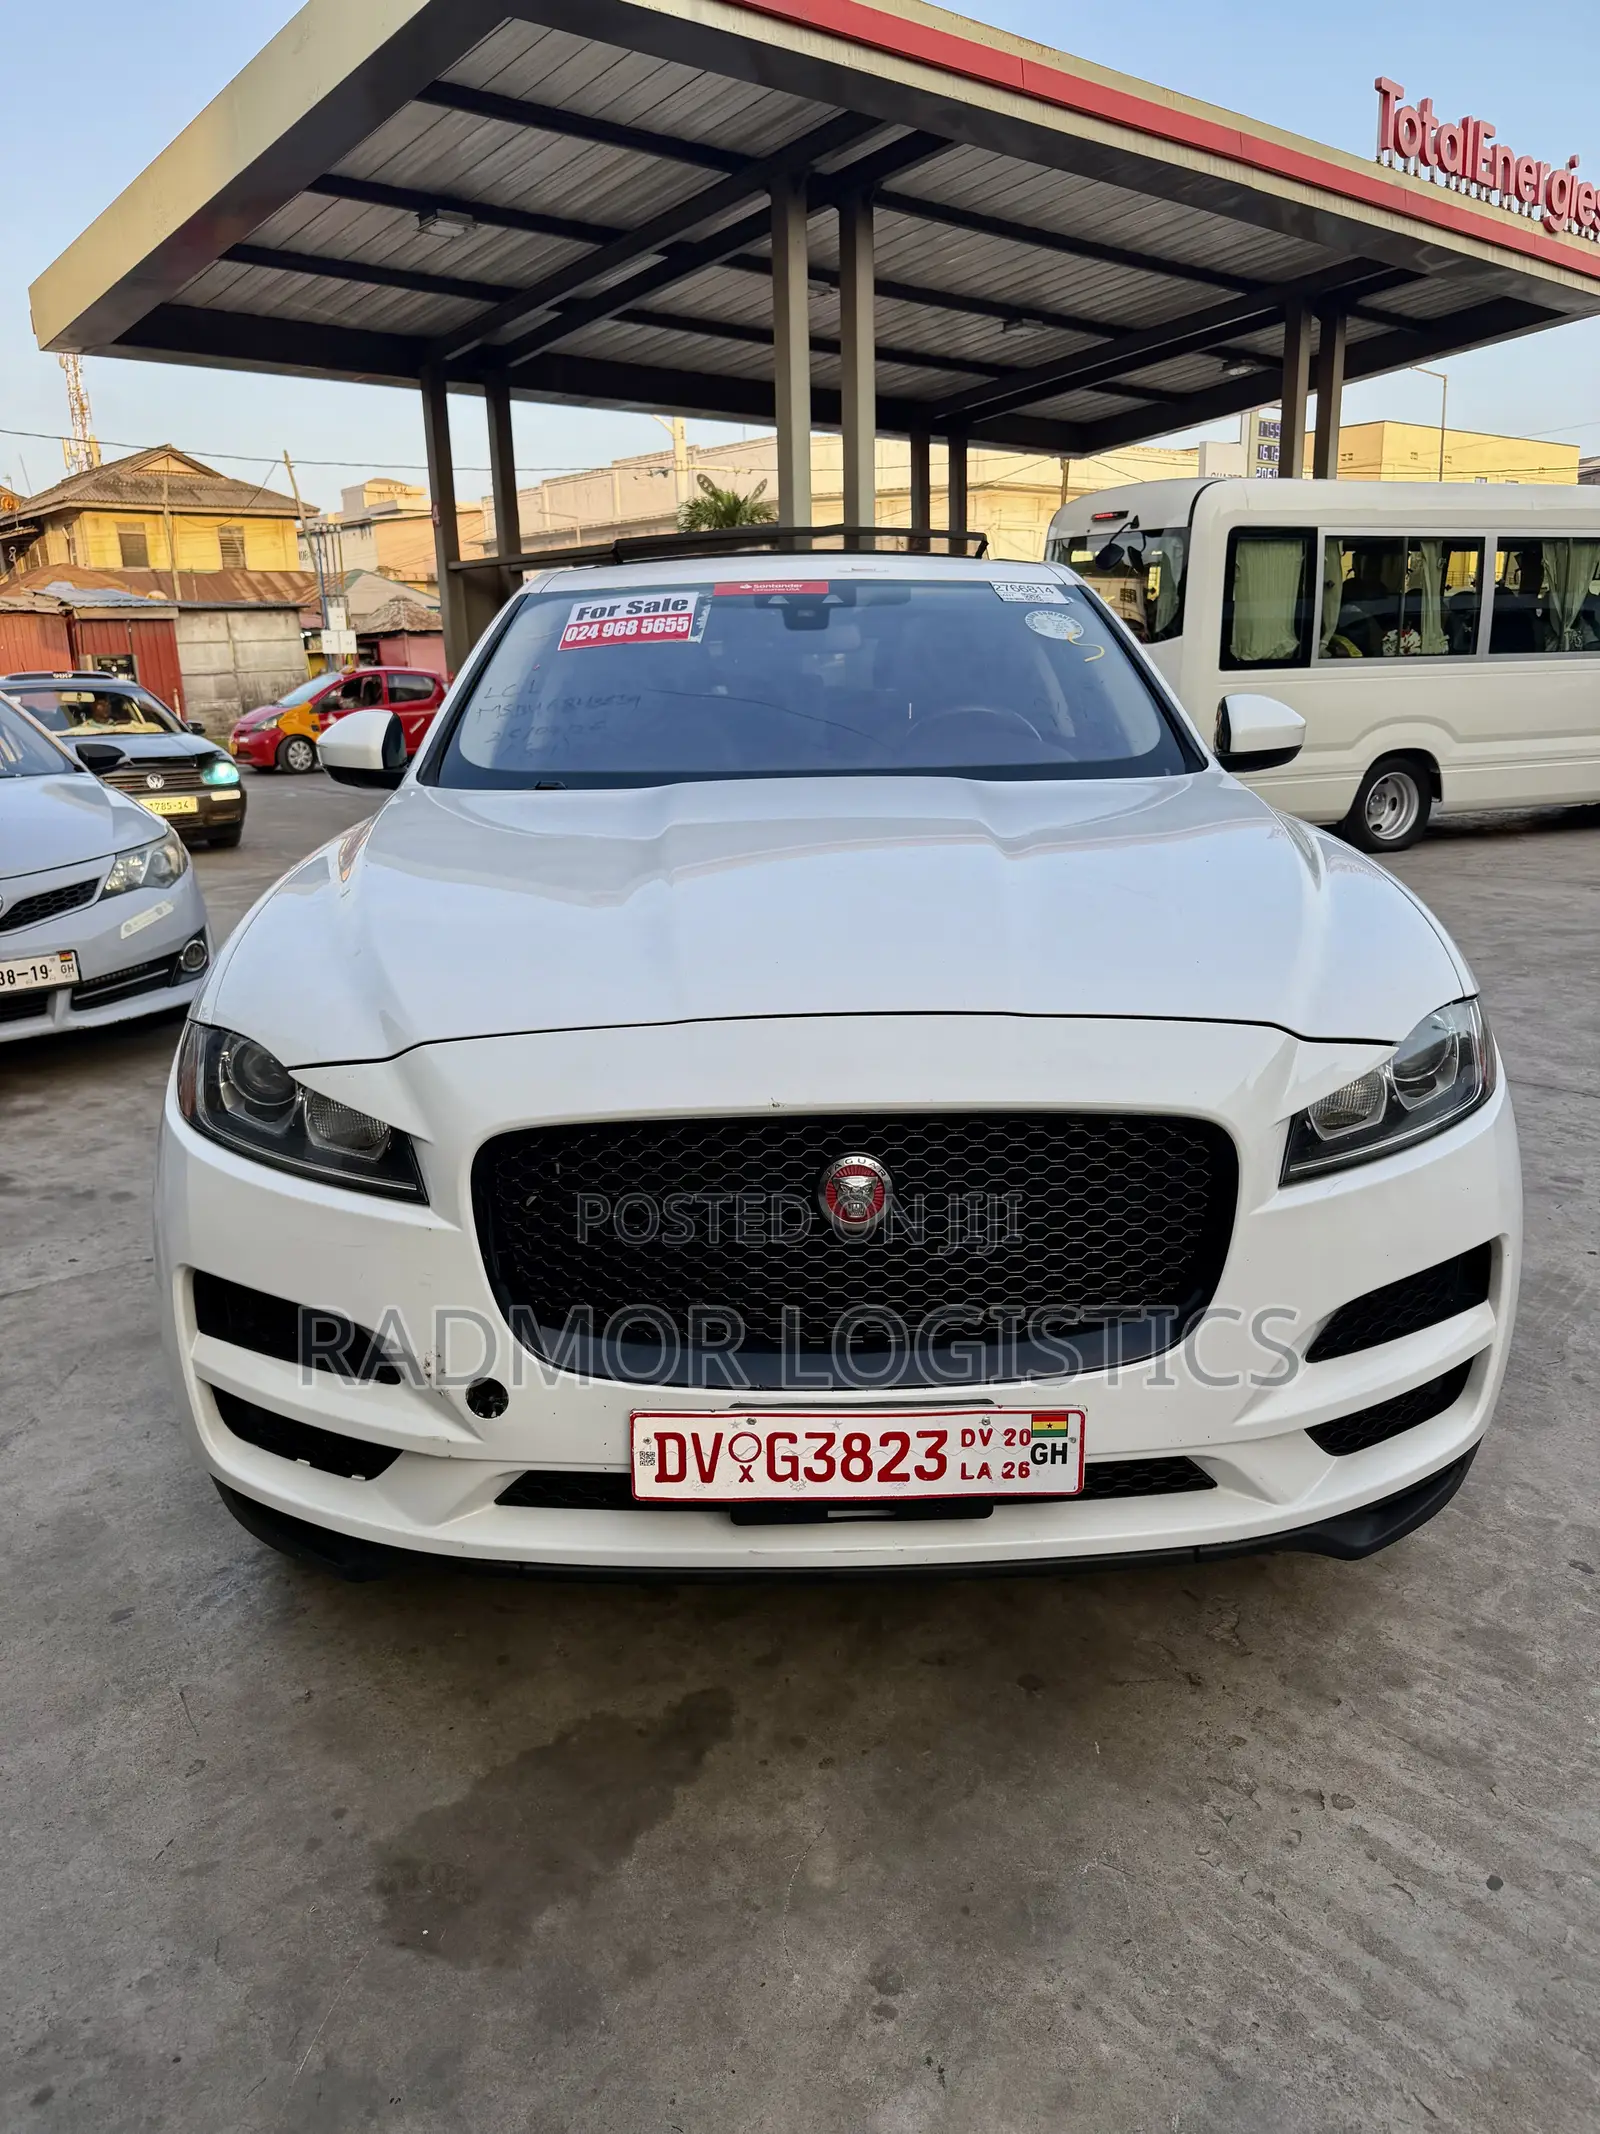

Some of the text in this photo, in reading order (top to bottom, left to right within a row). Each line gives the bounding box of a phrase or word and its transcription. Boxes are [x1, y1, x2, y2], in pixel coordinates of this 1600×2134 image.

[576, 597, 689, 621] For Sale
[564, 616, 690, 642] 024 968 5655
[60, 964, 75, 974] GH
[826, 1158, 887, 1178] JAGUAR
[960, 1427, 993, 1448] DV
[1003, 1428, 1032, 1447] 20
[1029, 1442, 1068, 1465] GH
[960, 1461, 1031, 1480] LA 26
